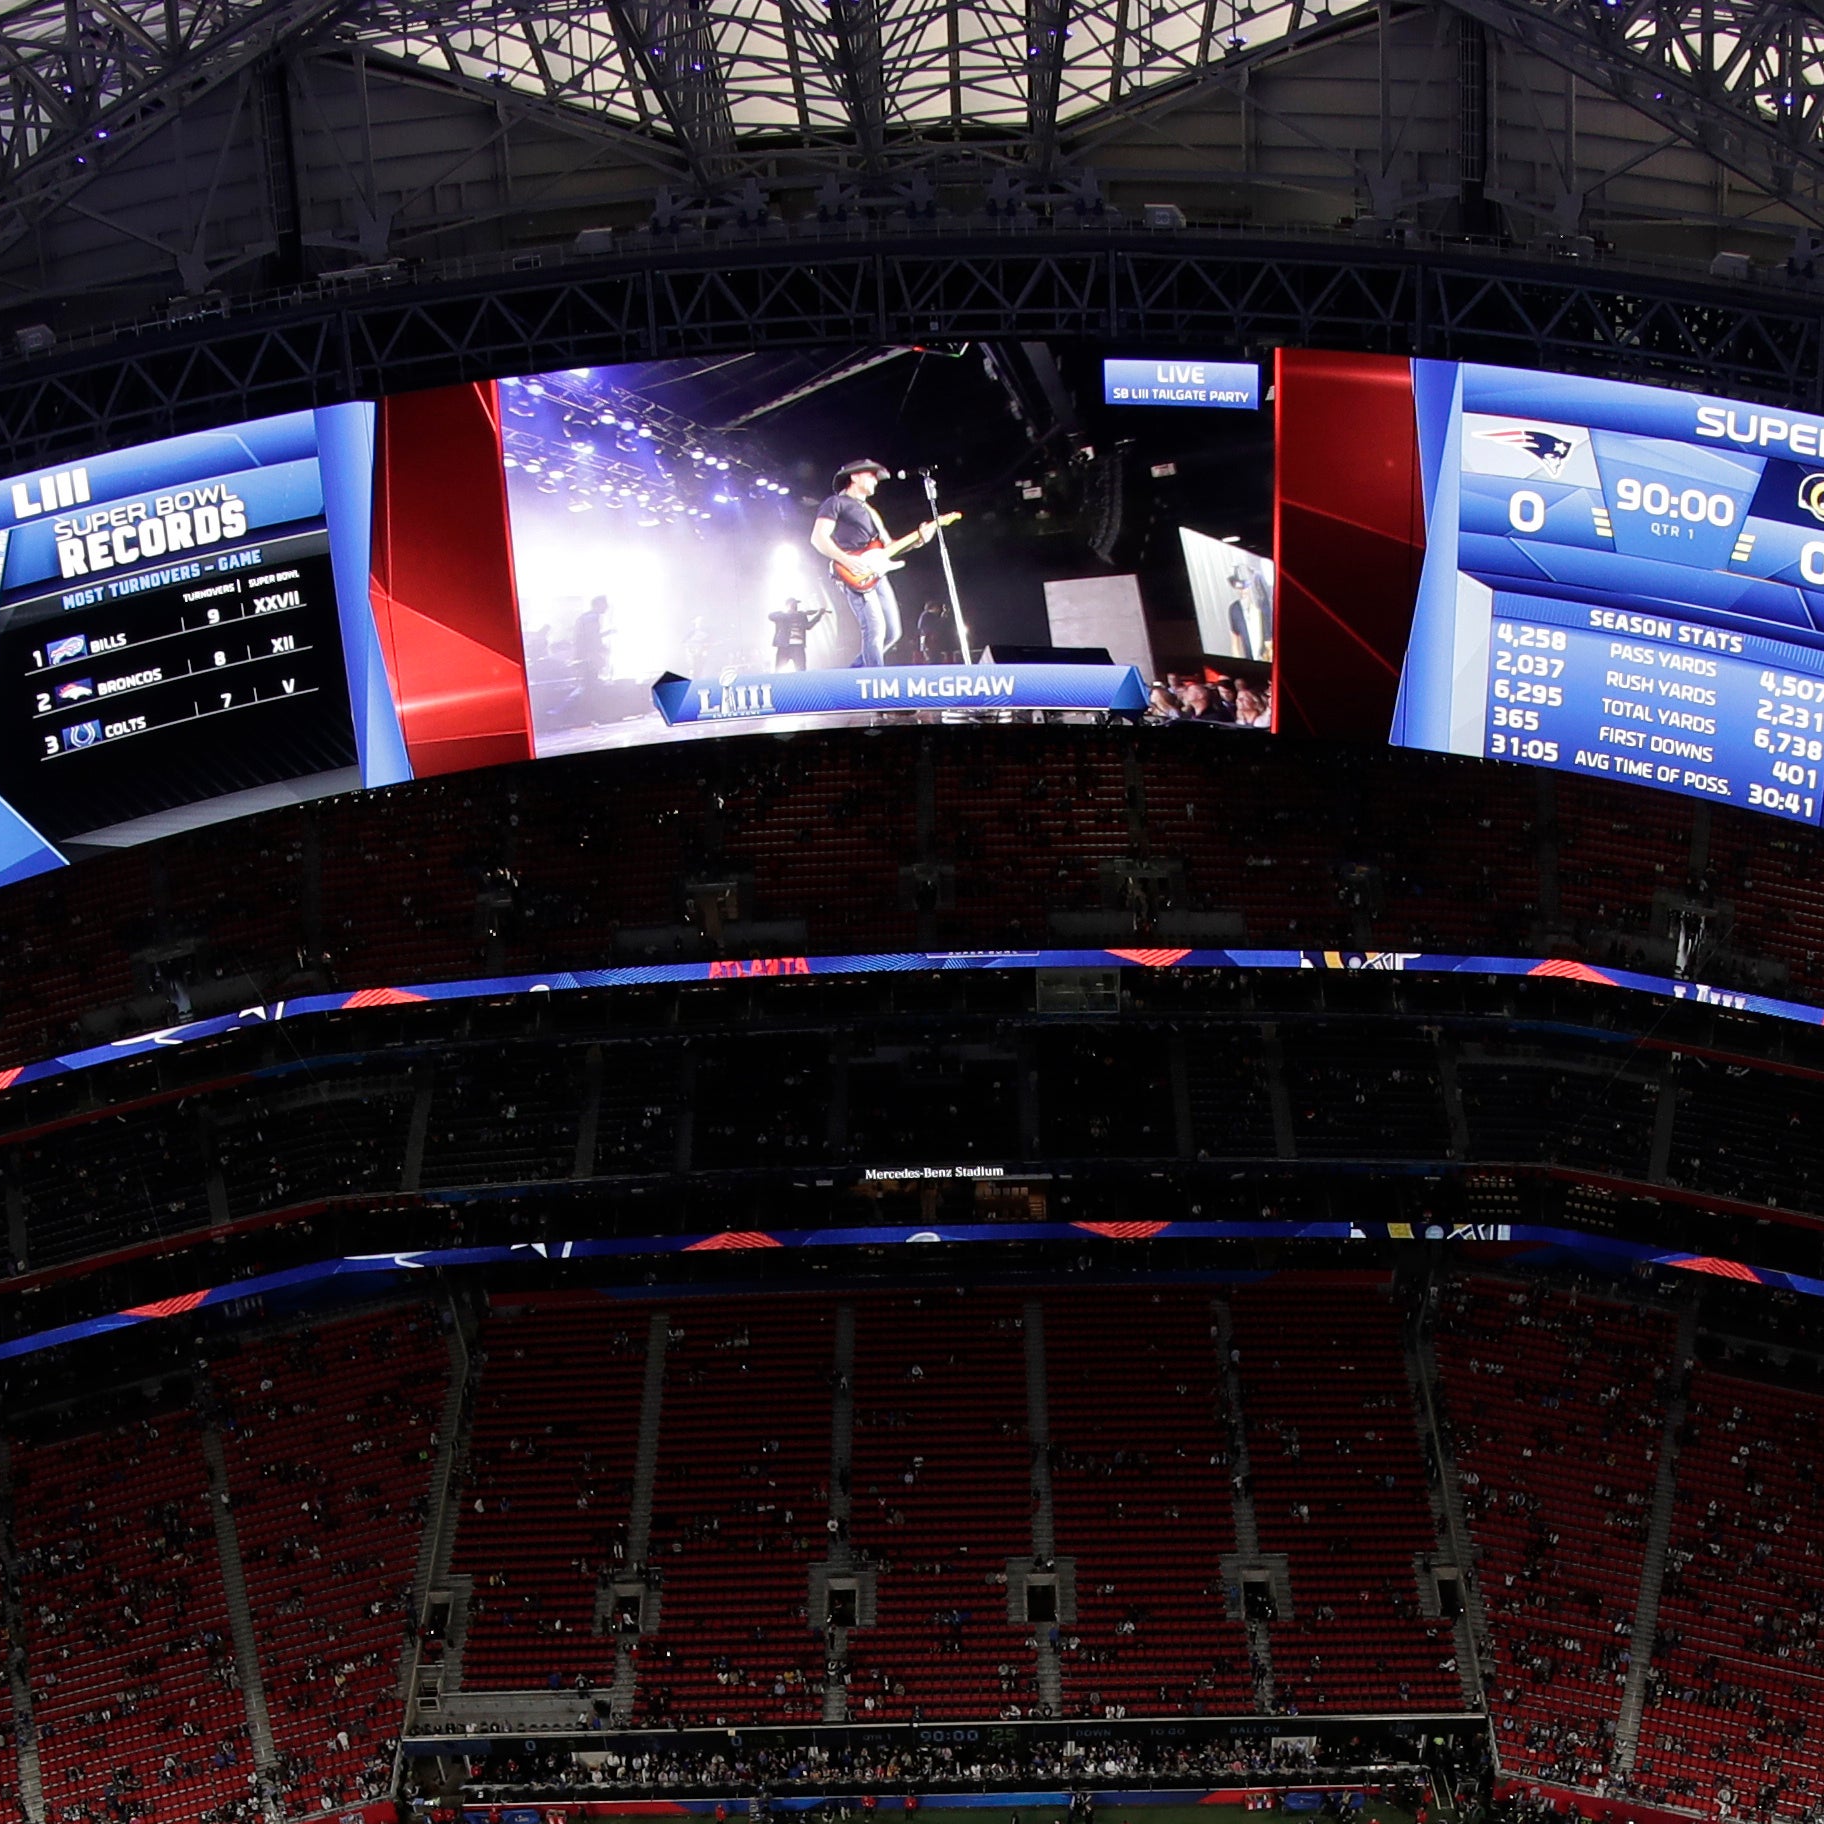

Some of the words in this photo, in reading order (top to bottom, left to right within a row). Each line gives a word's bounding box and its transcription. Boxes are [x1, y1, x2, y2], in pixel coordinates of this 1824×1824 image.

[1113, 388, 1128, 399] SB
[1132, 388, 1148, 399] LIII
[1152, 389, 1206, 401] TAILGATE
[1210, 391, 1249, 403] PARTY
[1157, 365, 1204, 384] LIVE
[11, 468, 91, 519] LIII
[54, 501, 148, 542] SUPER
[155, 483, 238, 513] BOWL
[1508, 490, 1545, 533] 0
[1616, 477, 1735, 528] 90:00
[56, 498, 247, 579] RECORDS
[1651, 522, 1681, 538] QTR
[63, 588, 104, 611] MOST
[108, 563, 200, 598] TURNOVERS
[217, 549, 262, 575] GAME
[90, 632, 127, 655] BILLS
[253, 590, 301, 615] XXVII
[1590, 609, 1671, 640] SEASON
[1678, 625, 1743, 653] STATS
[97, 667, 163, 698] BRONCOS
[271, 635, 295, 655] XII
[1497, 623, 1567, 651] 4,258
[1610, 643, 1655, 665] PASS
[1658, 652, 1717, 677] YARDS
[104, 716, 147, 740] COLTS
[281, 678, 296, 695] V
[856, 677, 899, 699] TIM
[907, 675, 1015, 698] McGRAW
[1496, 651, 1564, 679] 2,037
[1606, 671, 1654, 693] RUSH
[1658, 681, 1716, 706] YARDS
[1757, 699, 1823, 733] 2,231
[1493, 706, 1539, 731] 365
[1599, 727, 1647, 749] FIRST
[1650, 736, 1714, 763] DOWNS
[1772, 761, 1817, 789] 401
[1494, 679, 1562, 707] 6,295
[1602, 697, 1653, 723] TOTAL
[1657, 709, 1716, 735] YARDS
[1754, 729, 1823, 762] 6,738
[1491, 733, 1559, 762] 31:05
[1575, 750, 1610, 771] AVG
[1614, 756, 1654, 780] TIME
[1656, 765, 1679, 783] OF
[1684, 770, 1732, 796] POSS.
[1748, 783, 1814, 817] 30:41
[709, 957, 810, 979] ATLANTA
[865, 1168, 952, 1180] Mercedes-Benz
[955, 1166, 1004, 1177] Stadium
